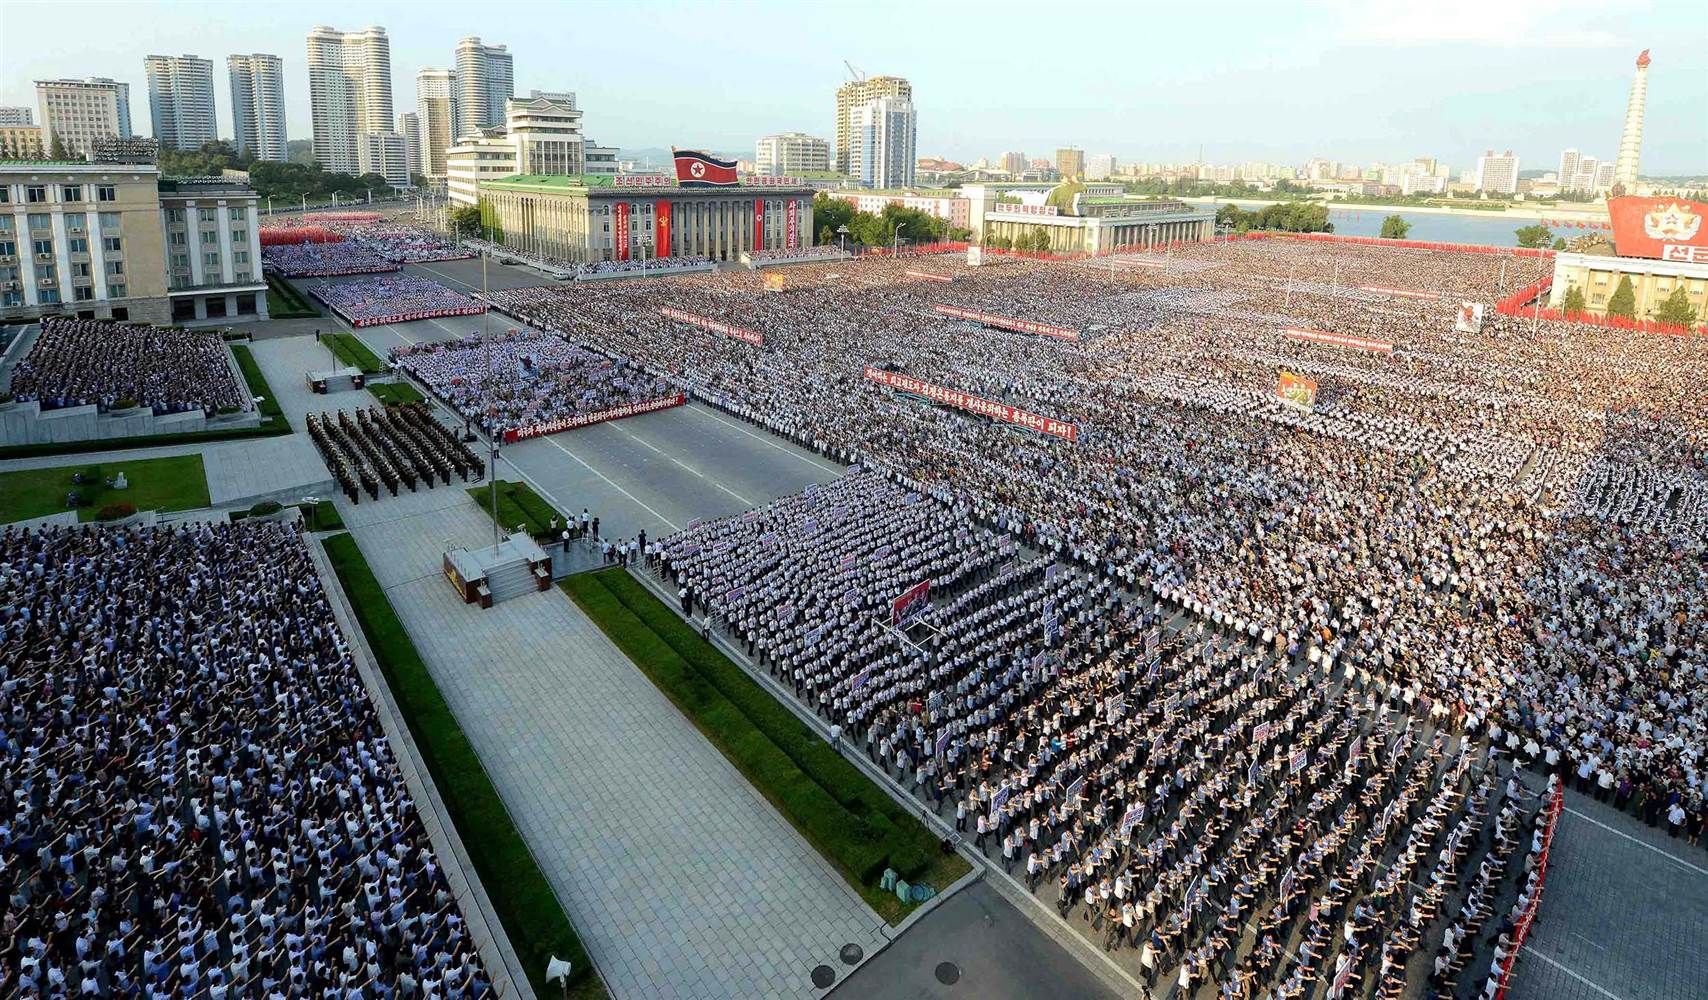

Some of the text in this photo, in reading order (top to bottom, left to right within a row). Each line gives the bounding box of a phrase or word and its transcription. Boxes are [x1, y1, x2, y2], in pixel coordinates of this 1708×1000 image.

[615, 176, 671, 186] 조선민주주의
[1012, 411, 1044, 429] 총폭탄이
[1047, 422, 1071, 438] 되자!
